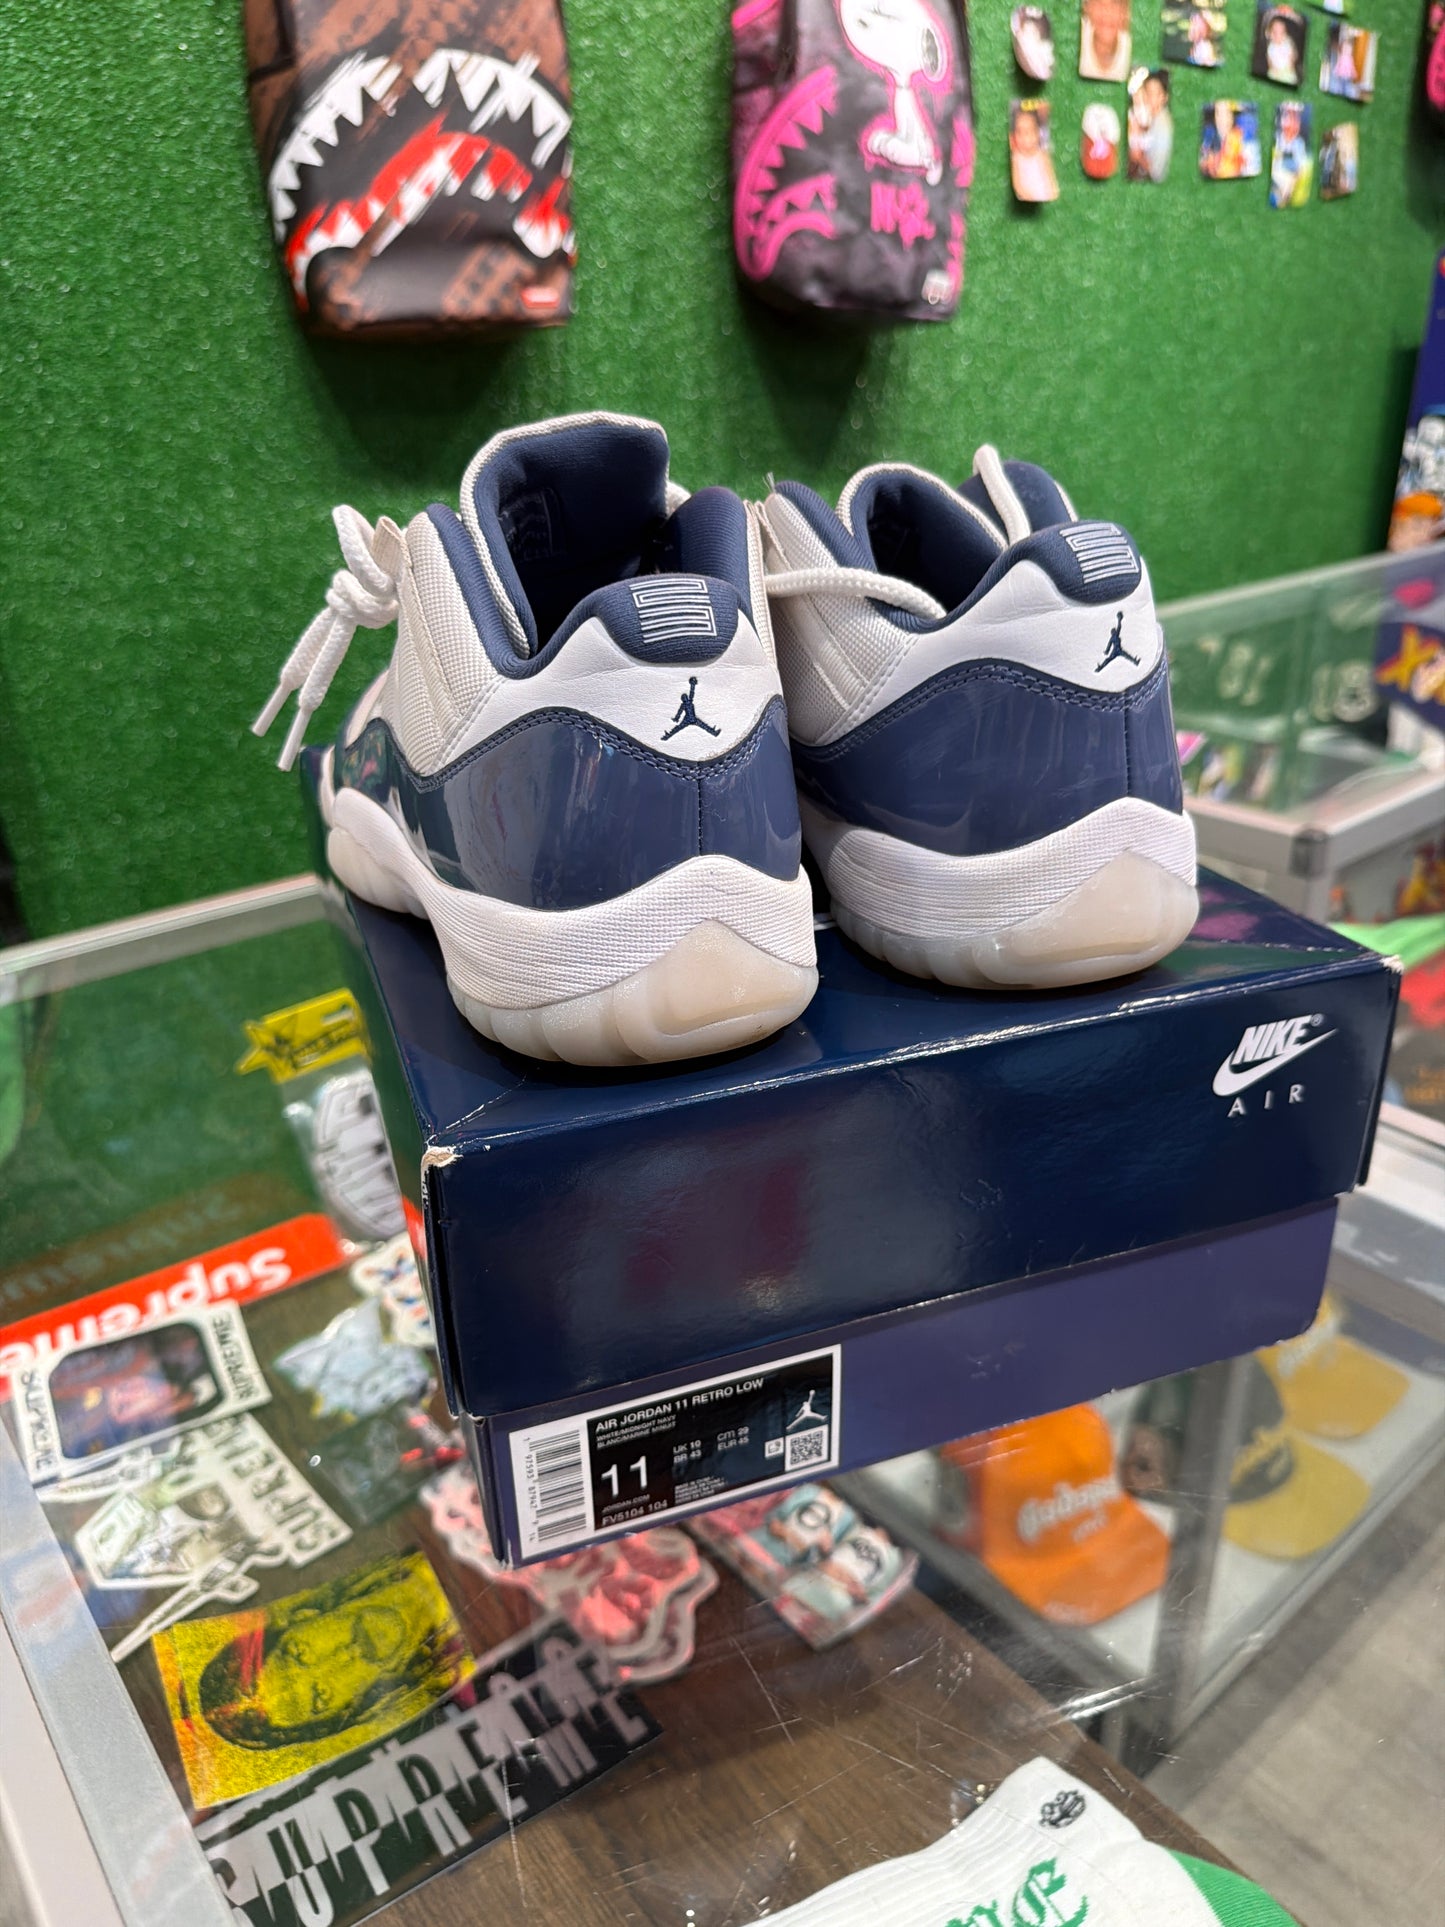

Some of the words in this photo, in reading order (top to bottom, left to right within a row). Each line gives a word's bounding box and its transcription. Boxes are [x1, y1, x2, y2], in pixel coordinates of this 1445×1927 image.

[1230, 1015, 1312, 1065] NIKE
[1227, 1083, 1305, 1118] AIR
[596, 1418, 618, 1432] AIR
[620, 1403, 672, 1425] JORDAN
[675, 1399, 688, 1410] 11
[692, 1386, 734, 1405] RETRO
[736, 1377, 764, 1394] LOW
[737, 1426, 750, 1436] 29
[673, 1443, 688, 1454] UK
[690, 1439, 702, 1449] 10
[717, 1439, 737, 1451] EUR
[738, 1436, 750, 1445] 45
[674, 1453, 688, 1464] BR
[690, 1449, 702, 1458] 43
[601, 1455, 648, 1498] 11
[601, 1494, 650, 1513] JORDAN.COM
[602, 1506, 644, 1526] FV5104
[648, 1499, 668, 1512] 104
